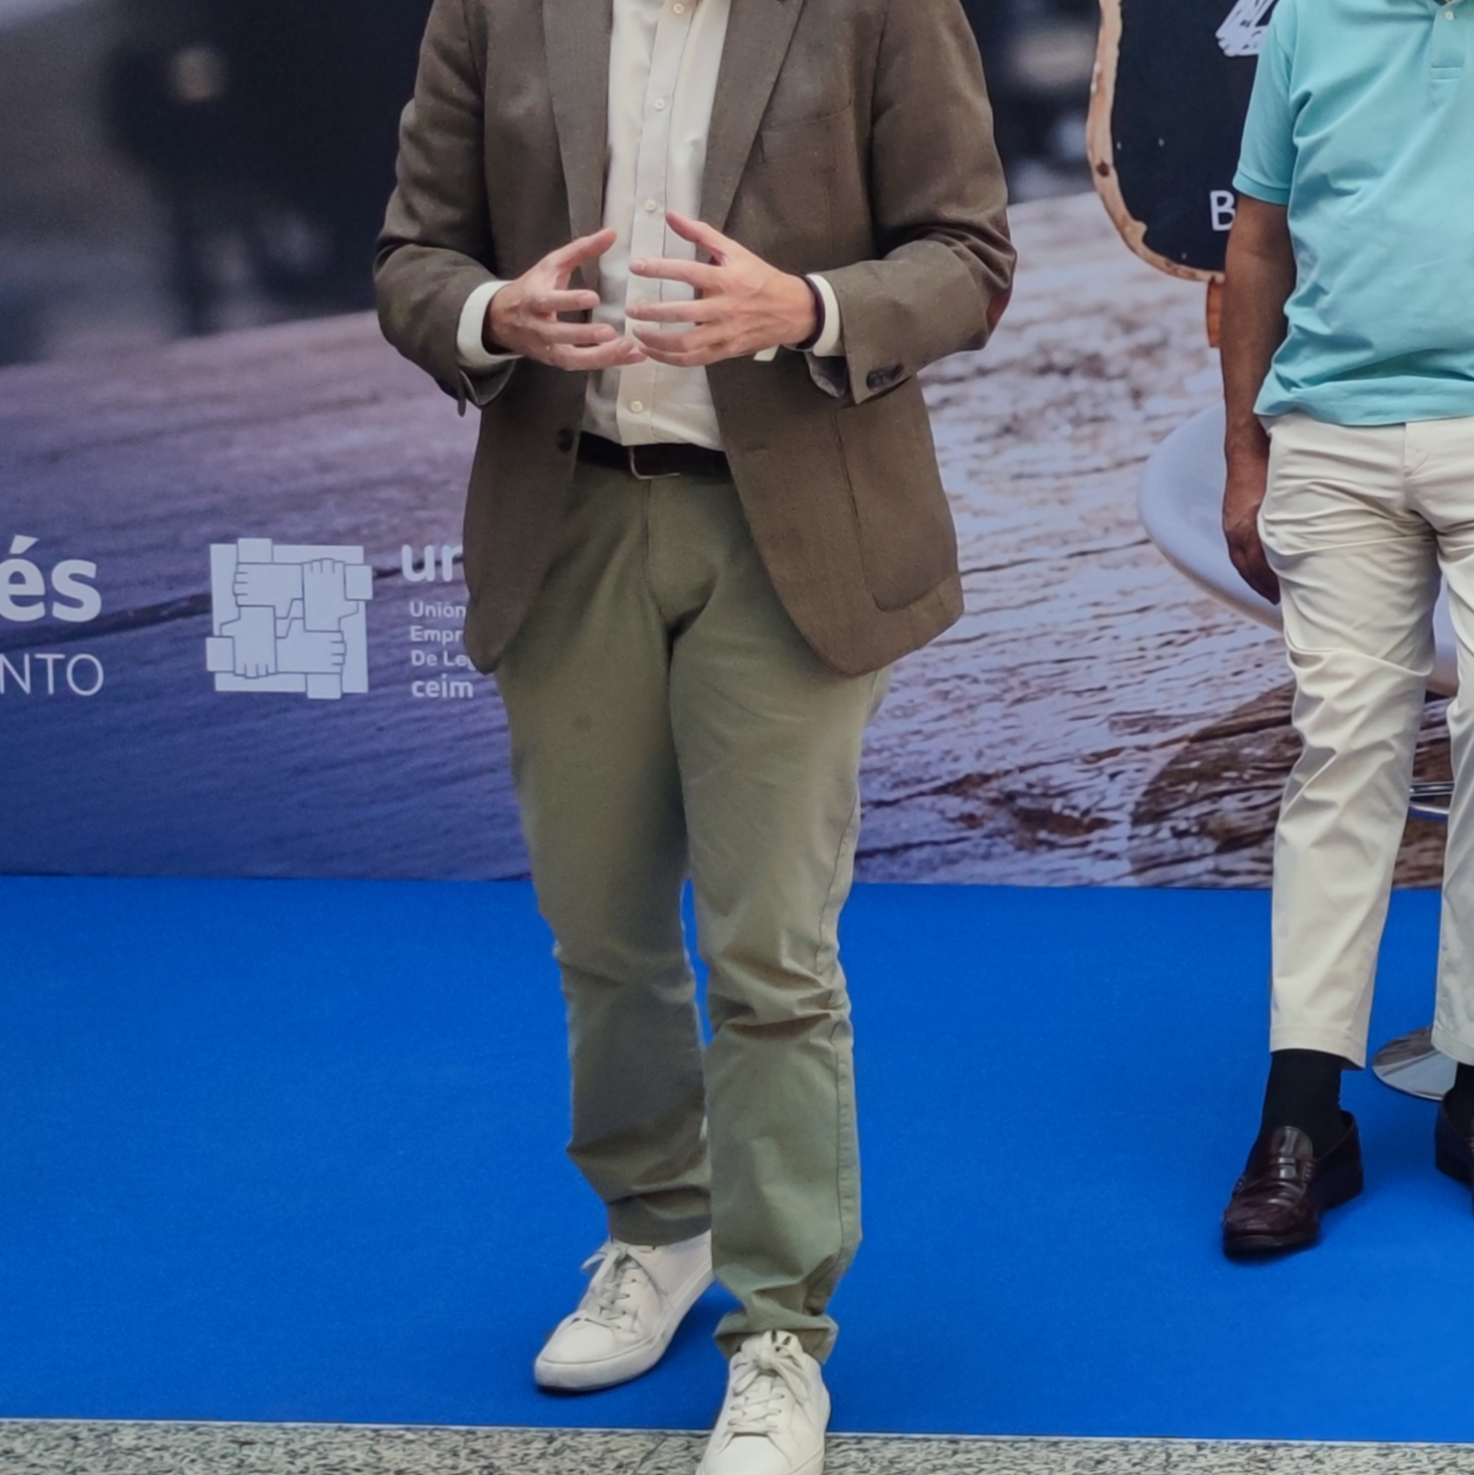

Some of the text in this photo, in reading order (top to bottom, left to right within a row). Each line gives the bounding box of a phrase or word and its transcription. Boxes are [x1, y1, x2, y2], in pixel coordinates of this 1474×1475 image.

[0, 534, 102, 622] és
[0, 652, 104, 696] NTO
[411, 649, 438, 667] De
[411, 673, 474, 699] ceim
